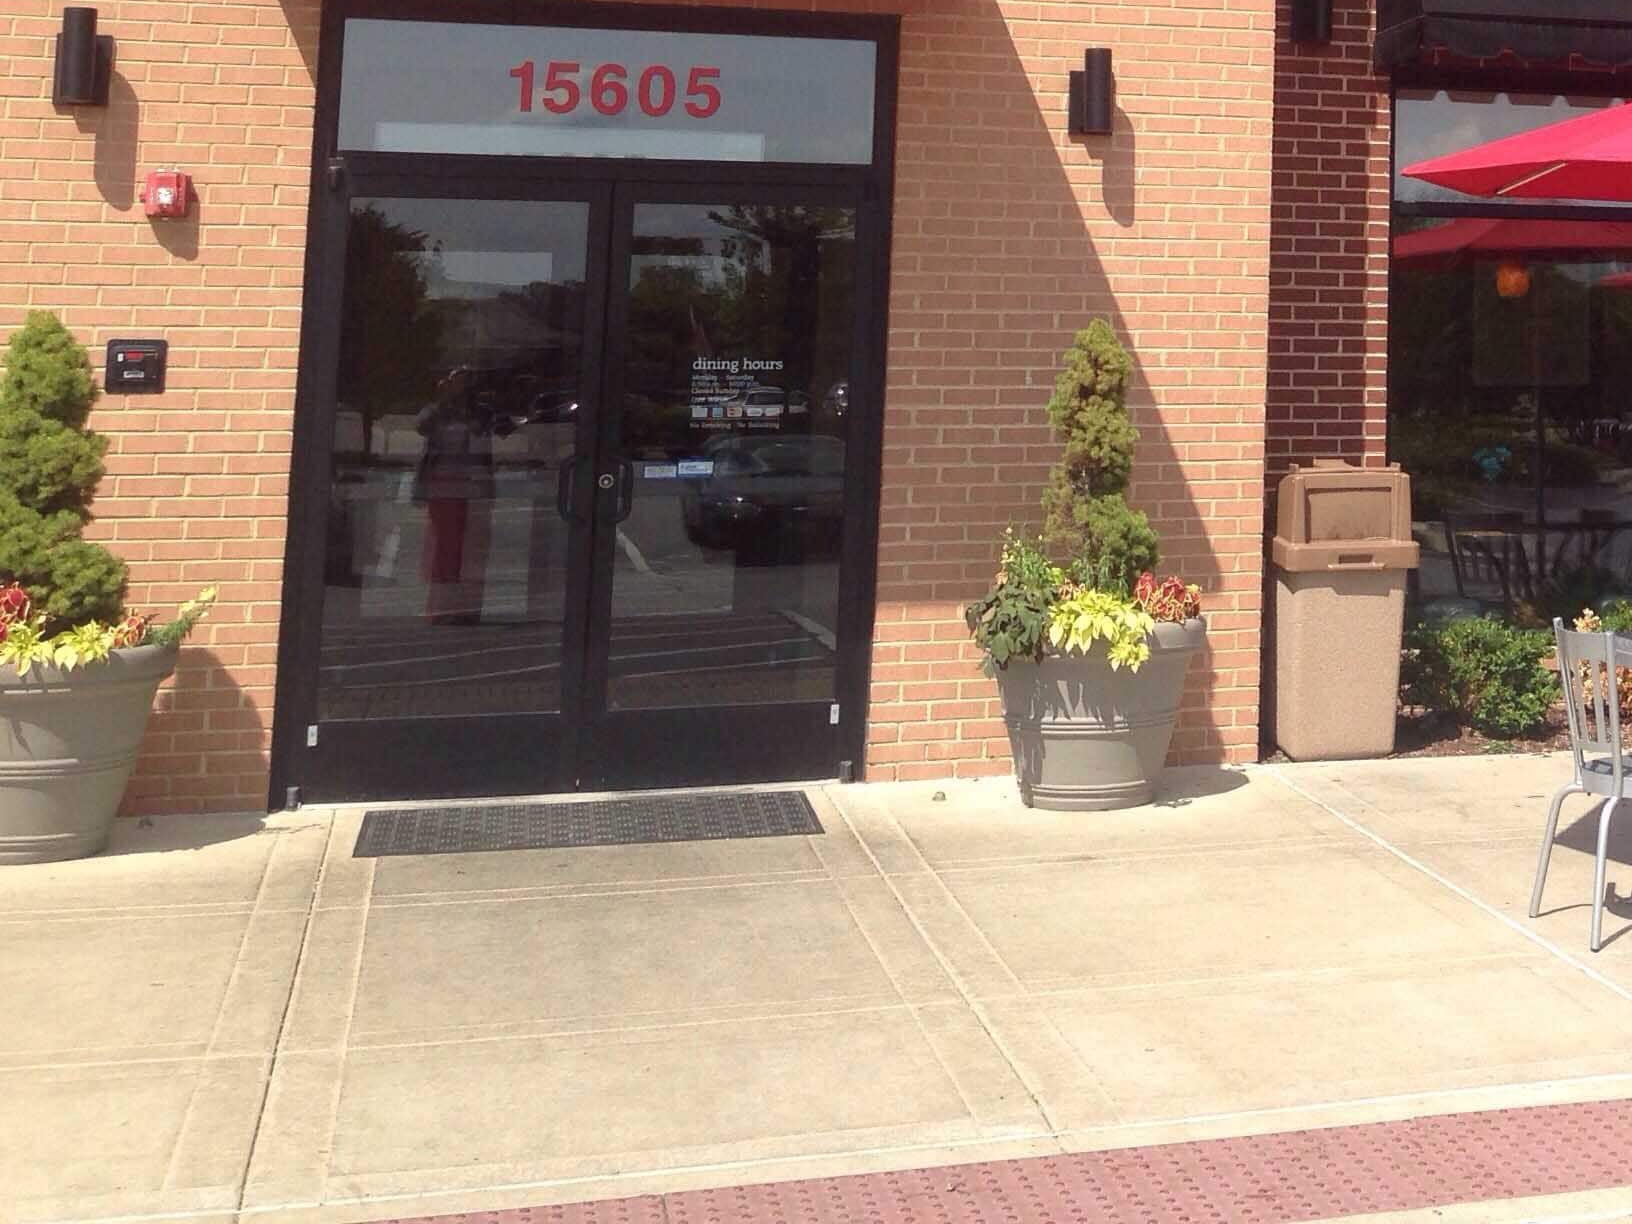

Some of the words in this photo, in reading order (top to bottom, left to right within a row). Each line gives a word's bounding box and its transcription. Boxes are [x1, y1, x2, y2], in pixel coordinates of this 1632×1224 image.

[509, 60, 722, 119] 15605
[692, 357, 739, 373] dining
[743, 358, 784, 370] hours
